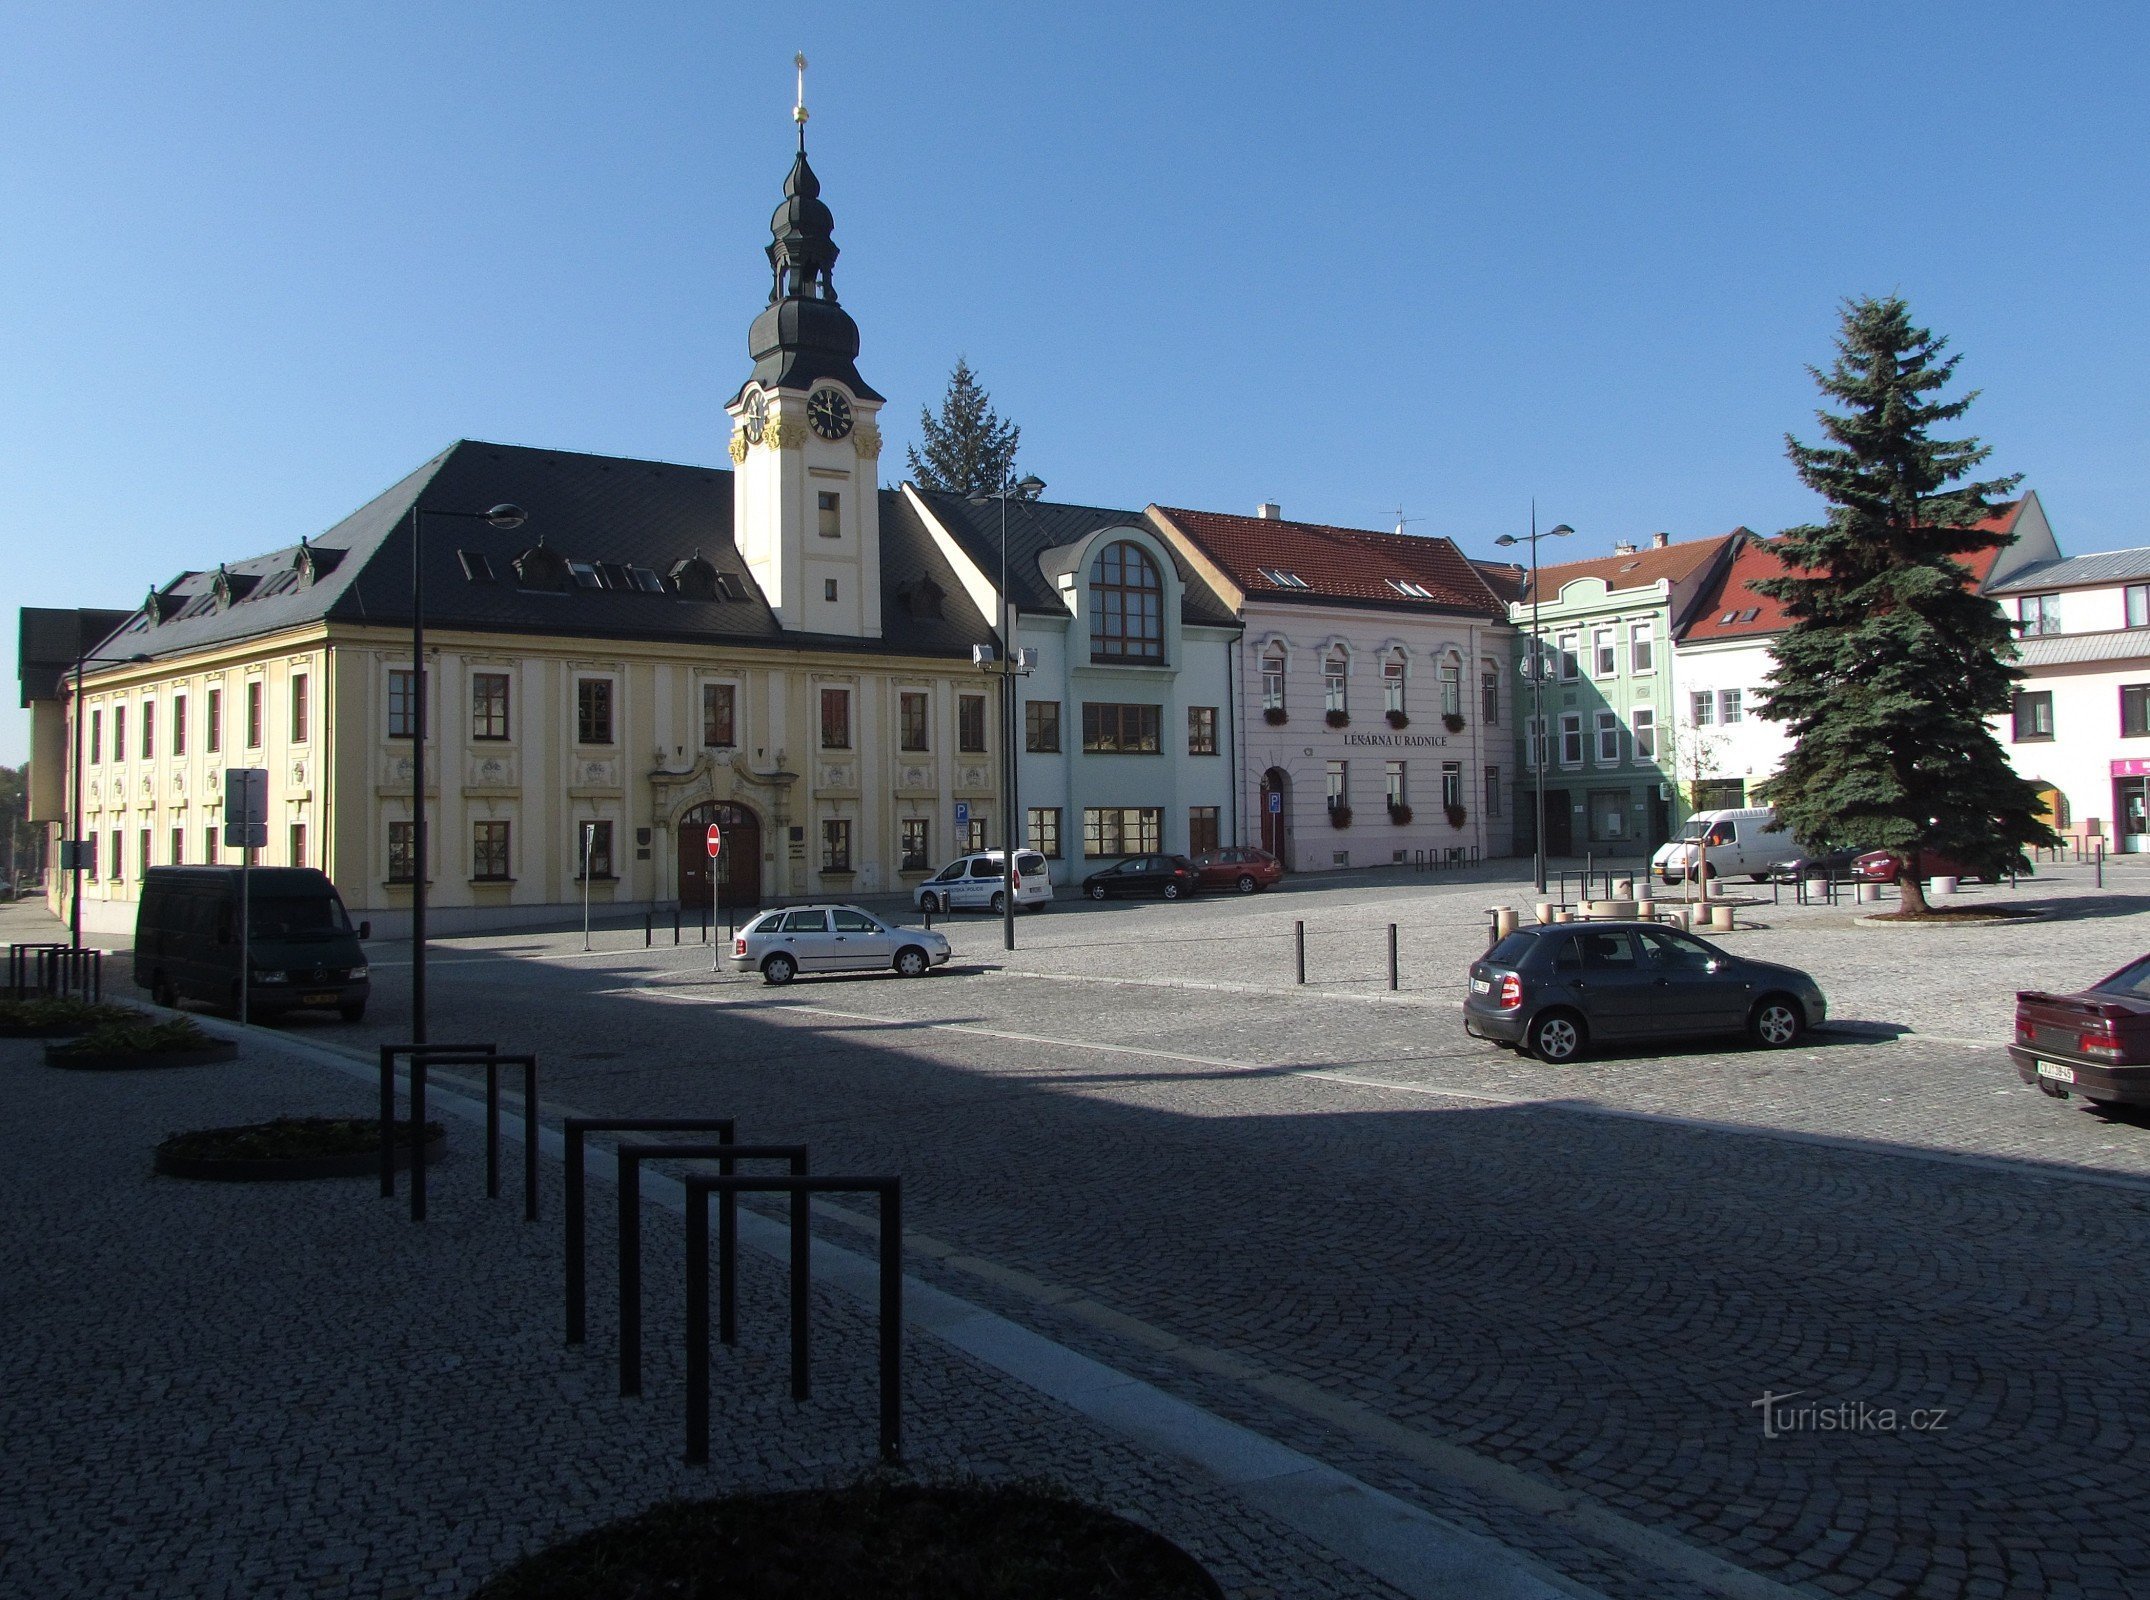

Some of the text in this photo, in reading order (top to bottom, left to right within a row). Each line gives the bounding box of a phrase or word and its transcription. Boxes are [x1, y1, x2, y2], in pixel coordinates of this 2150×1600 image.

[1395, 735, 1402, 746] U
[1404, 736, 1447, 747] RADNICE
[1271, 795, 1278, 807] P
[957, 804, 966, 819] P
